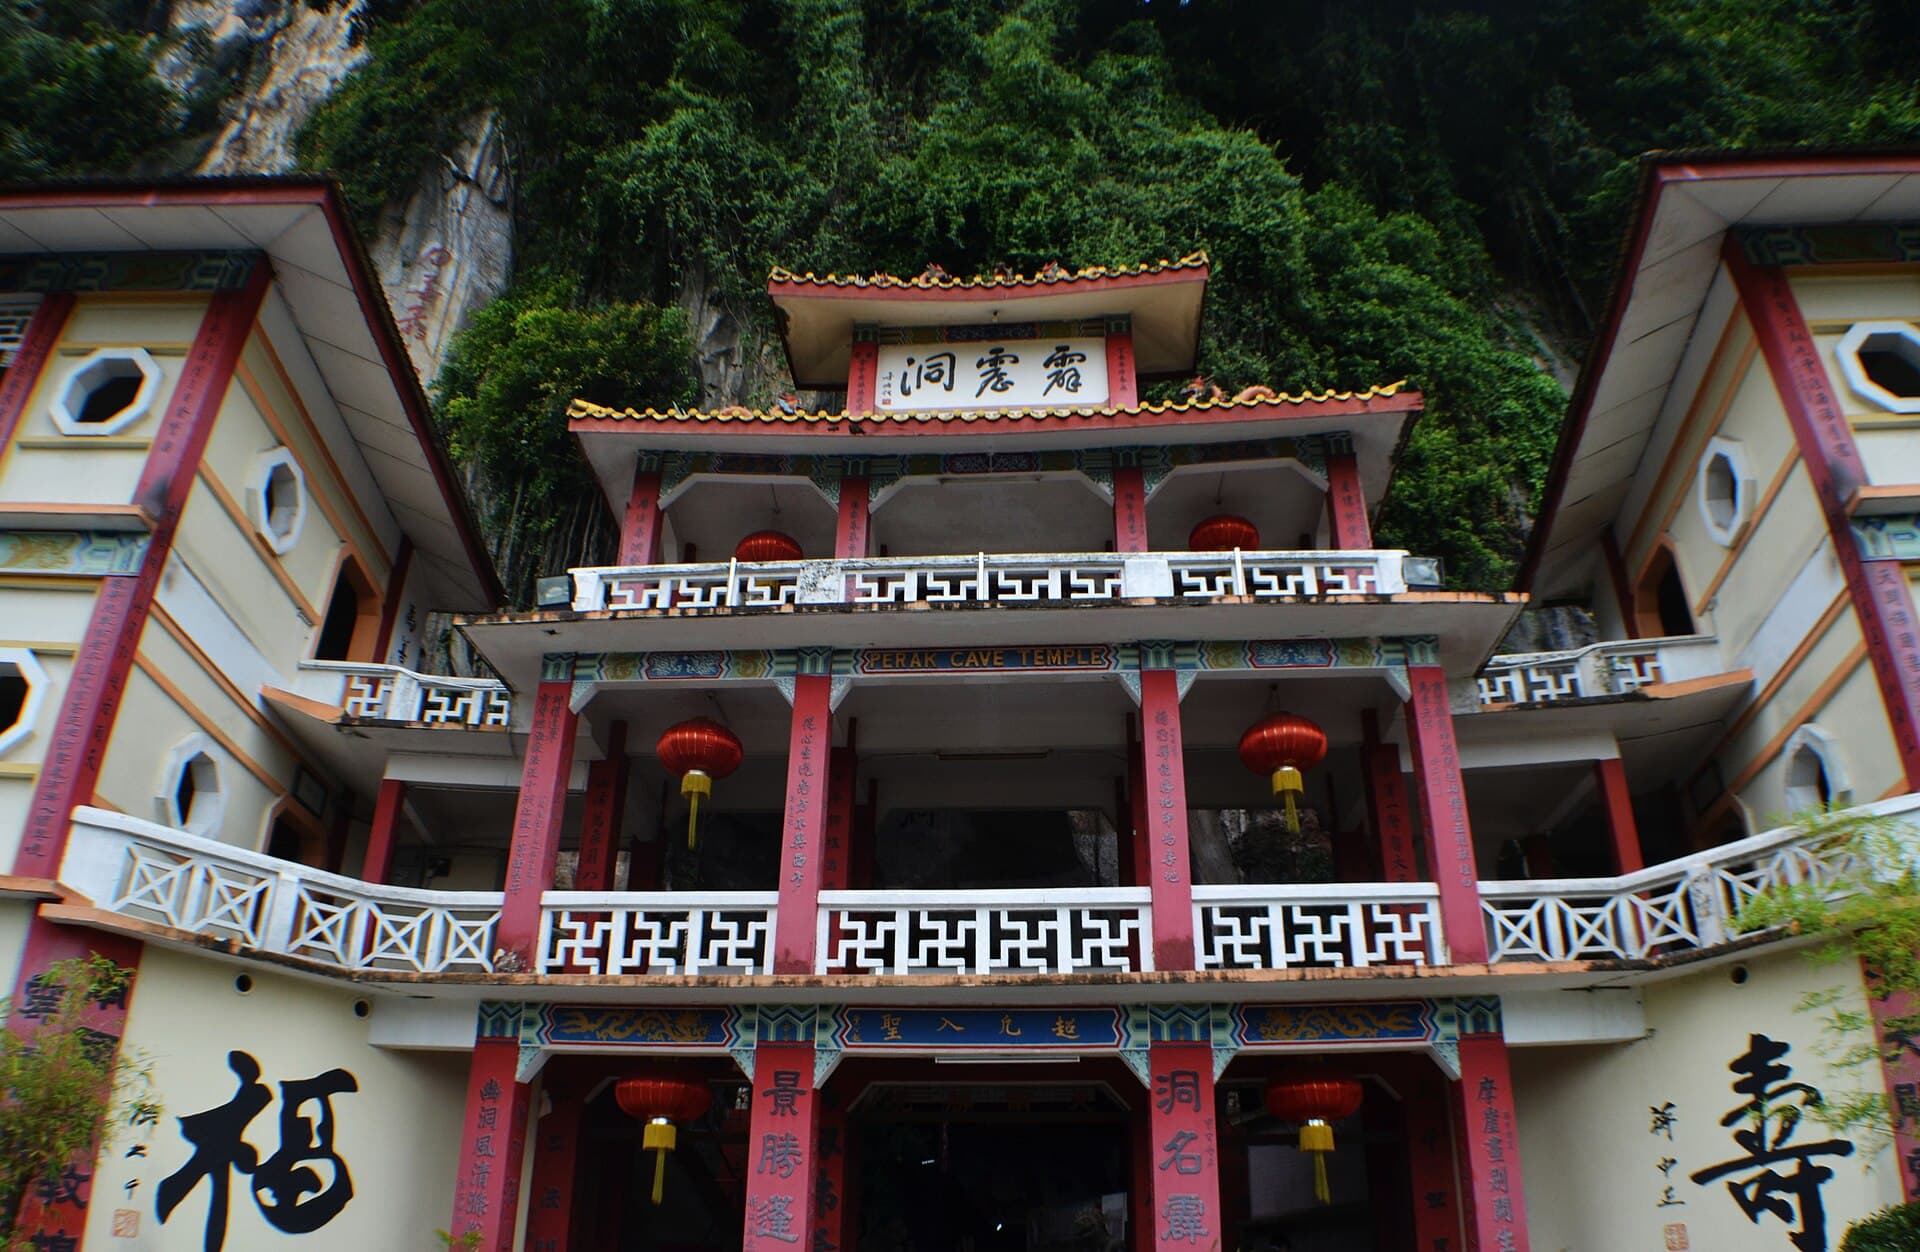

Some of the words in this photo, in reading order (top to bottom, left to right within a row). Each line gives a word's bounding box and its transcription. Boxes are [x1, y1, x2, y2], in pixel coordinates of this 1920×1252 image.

[869, 650, 937, 669] PERAK
[950, 649, 1004, 668] CAVE
[1019, 647, 1103, 667] TEMPLE
[155, 1050, 359, 1252] 福
